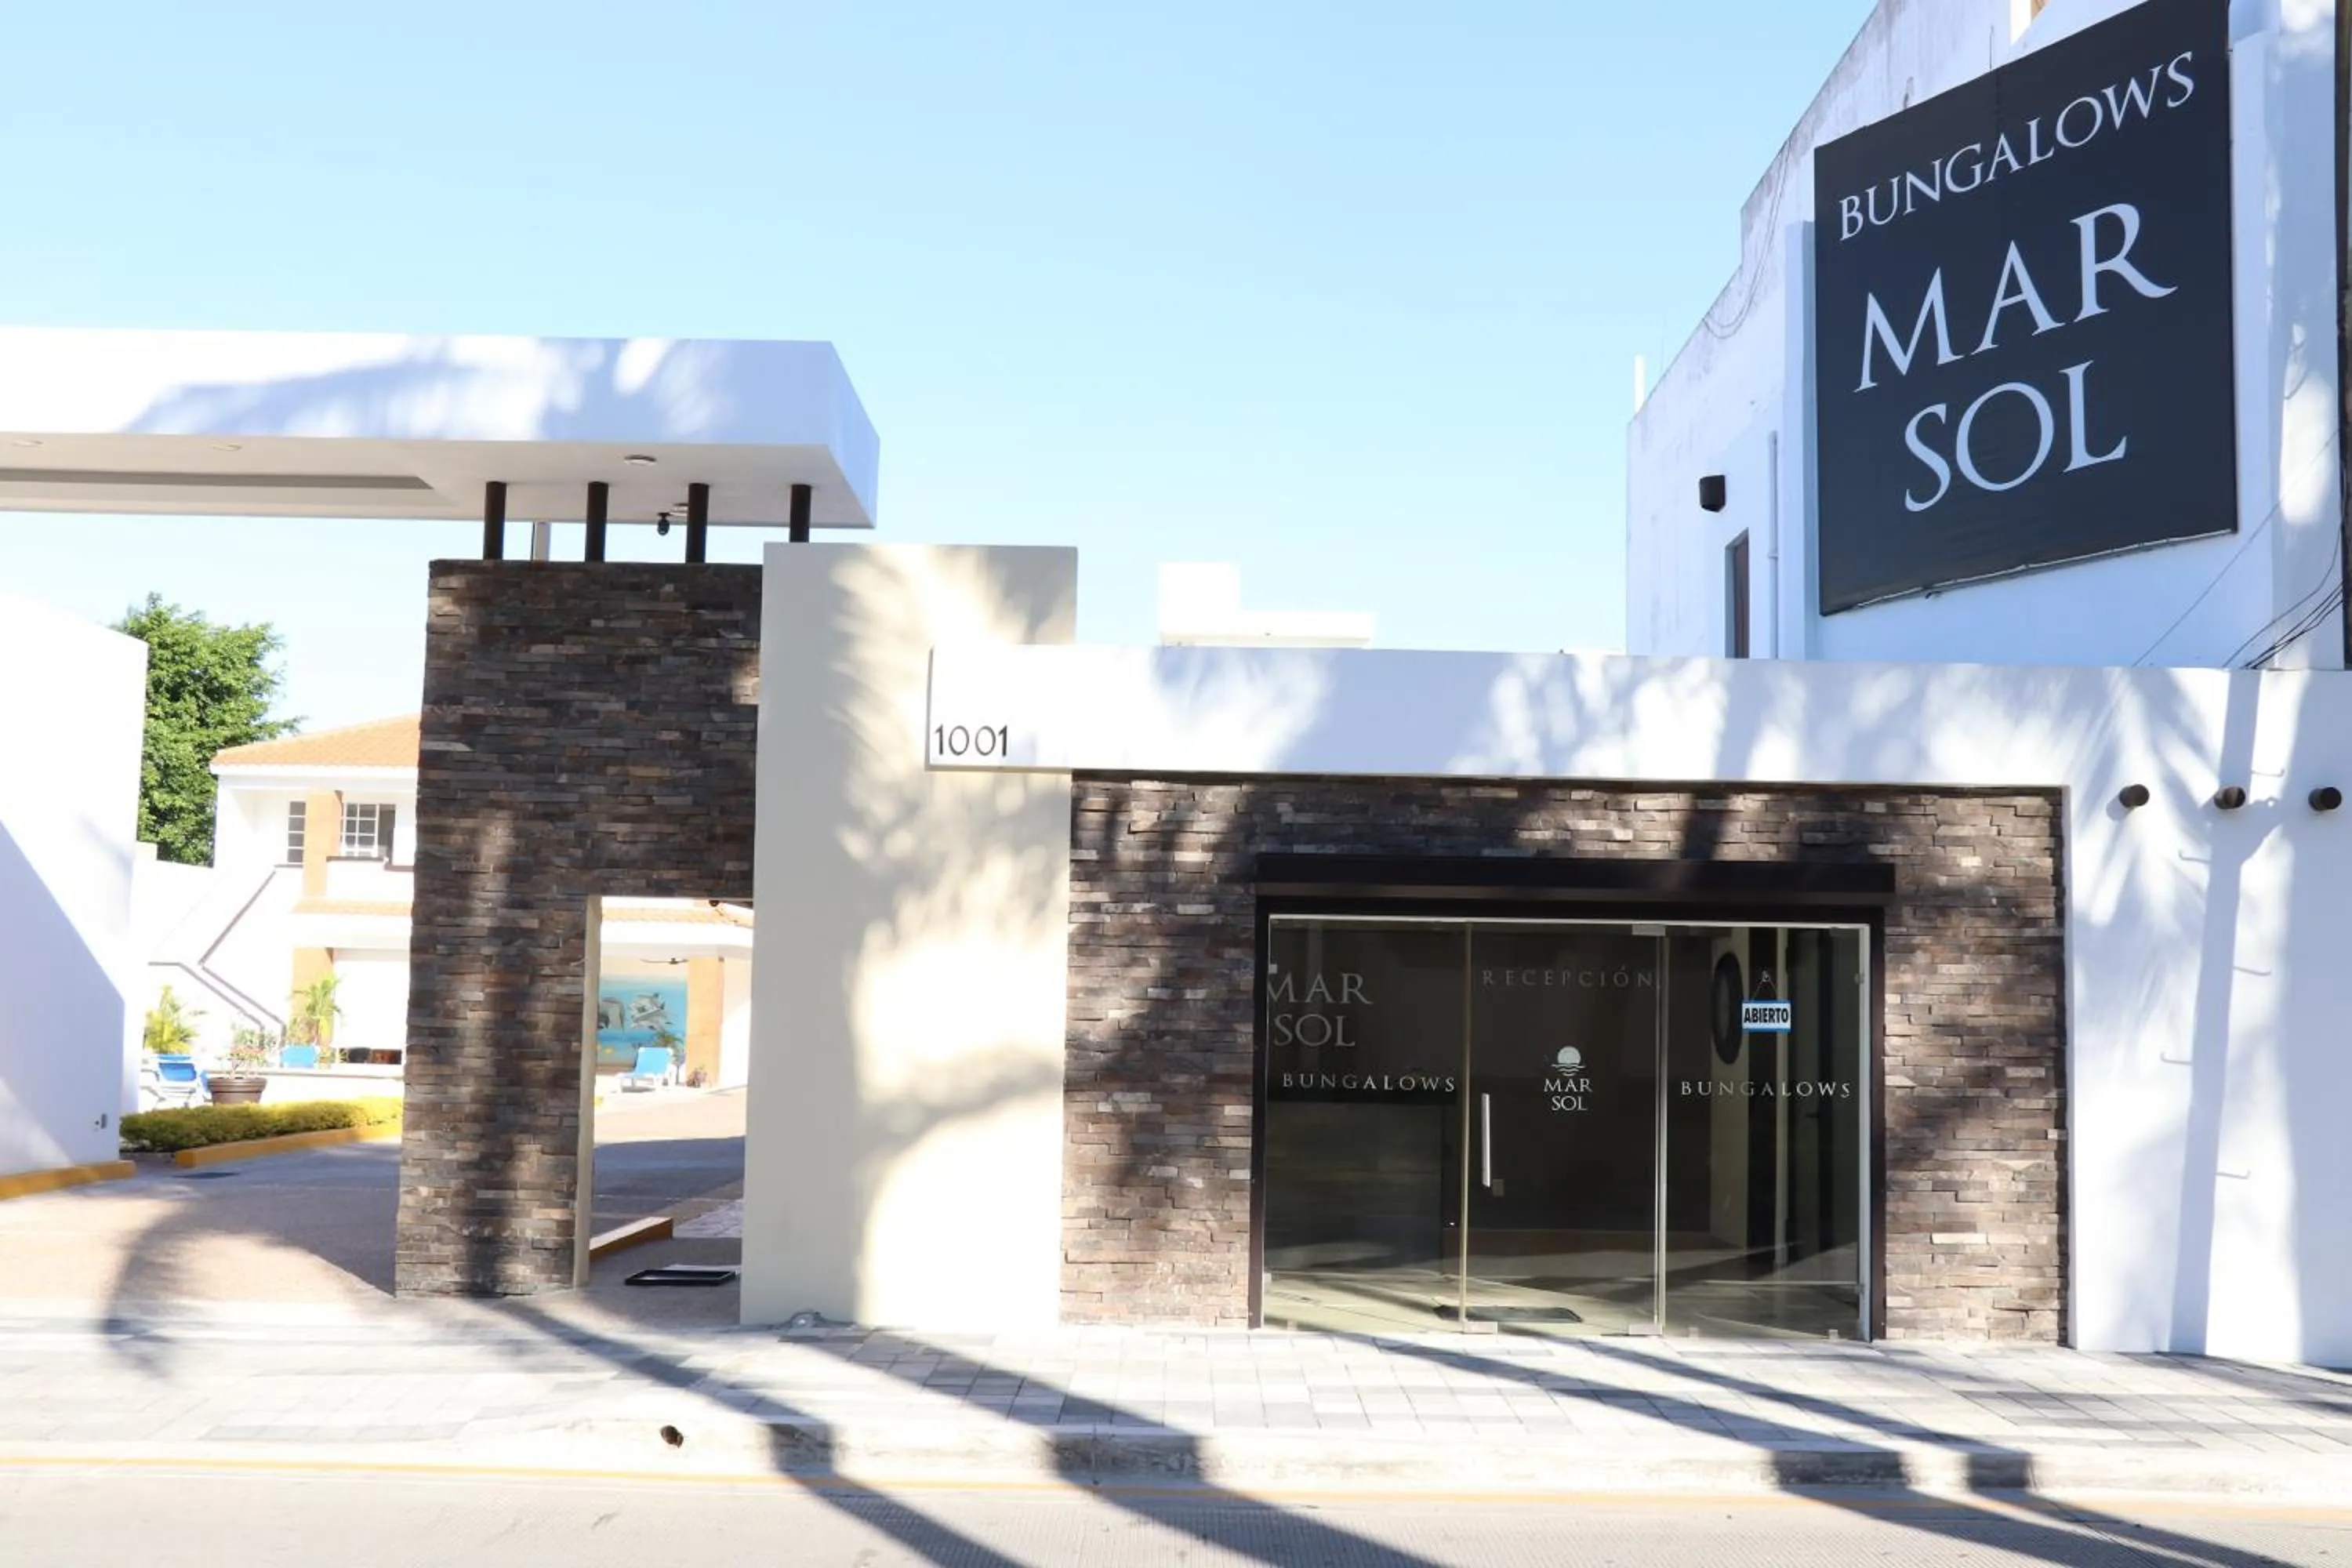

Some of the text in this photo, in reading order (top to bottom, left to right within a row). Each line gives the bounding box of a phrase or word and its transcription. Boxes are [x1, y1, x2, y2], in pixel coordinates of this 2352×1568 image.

[1838, 51, 2195, 241] BUNGALOWS
[1853, 203, 2178, 393] MAR
[1904, 360, 2126, 512] SOL
[935, 724, 1007, 757] 1001
[1268, 972, 1374, 1004] MAR
[1482, 964, 1652, 987] RECEPCIÓN
[1744, 1007, 1789, 1023] ABIERTO
[1273, 1014, 1356, 1047] SOL
[1283, 1073, 1455, 1092] BUNGALOWS
[1544, 1078, 1593, 1092] MAR
[1681, 1081, 1850, 1098] BUNGALOWS
[1552, 1096, 1588, 1111] SOL
